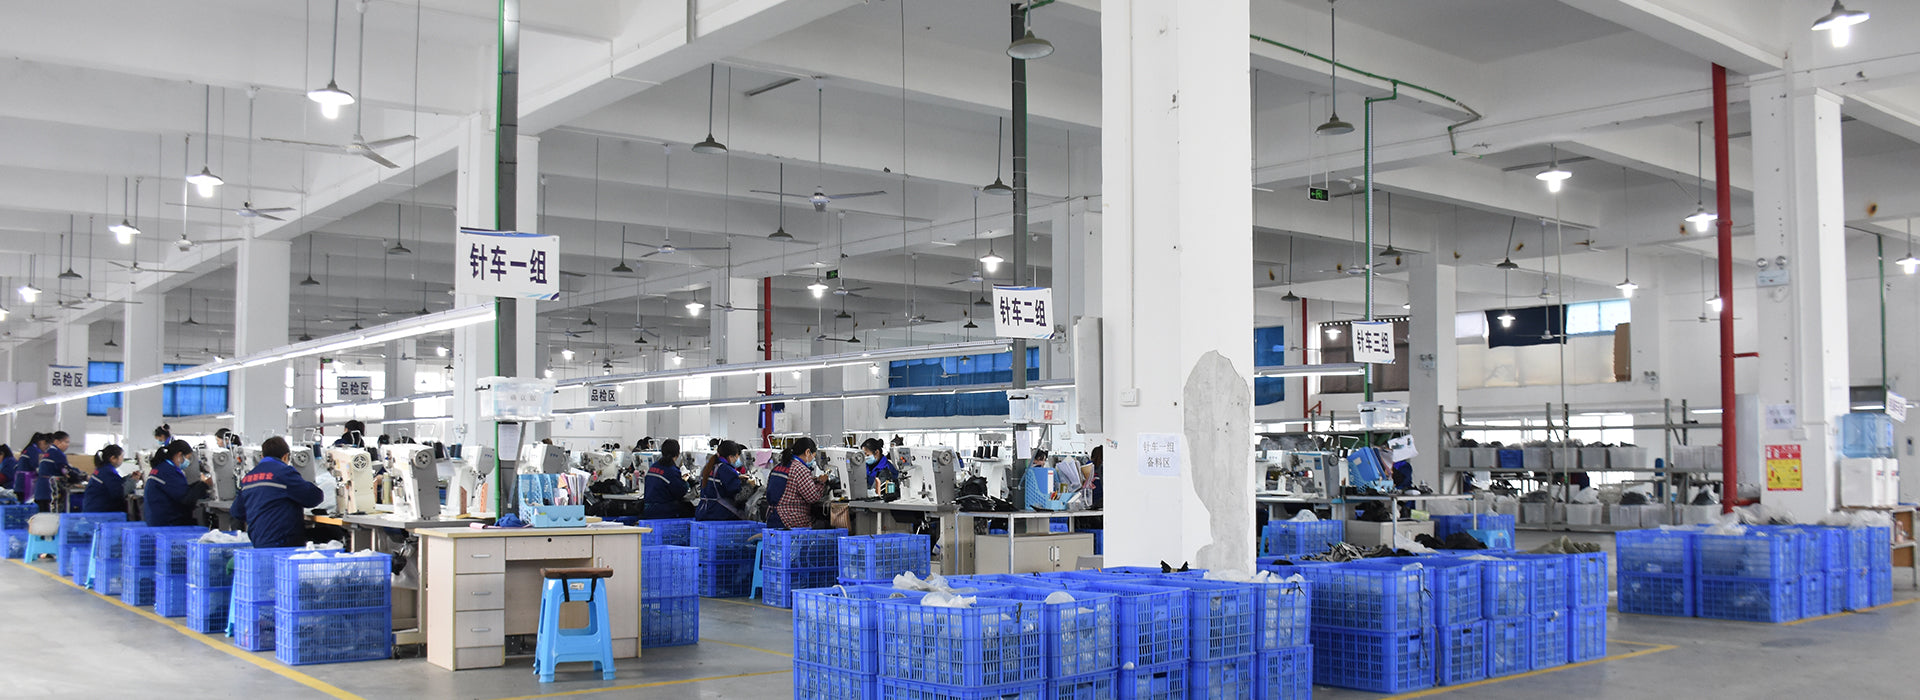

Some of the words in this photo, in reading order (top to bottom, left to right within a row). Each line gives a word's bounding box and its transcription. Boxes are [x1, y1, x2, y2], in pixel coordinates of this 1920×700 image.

[469, 243, 548, 284] 针车一组
[1000, 296, 1047, 327] 针车二组
[1357, 329, 1390, 354] 针车三组
[52, 371, 83, 387] 品检区
[340, 381, 369, 396] 品检区
[591, 389, 616, 402] 品检区
[1143, 440, 1175, 453] 针车一组
[1147, 456, 1171, 468] 备料区
